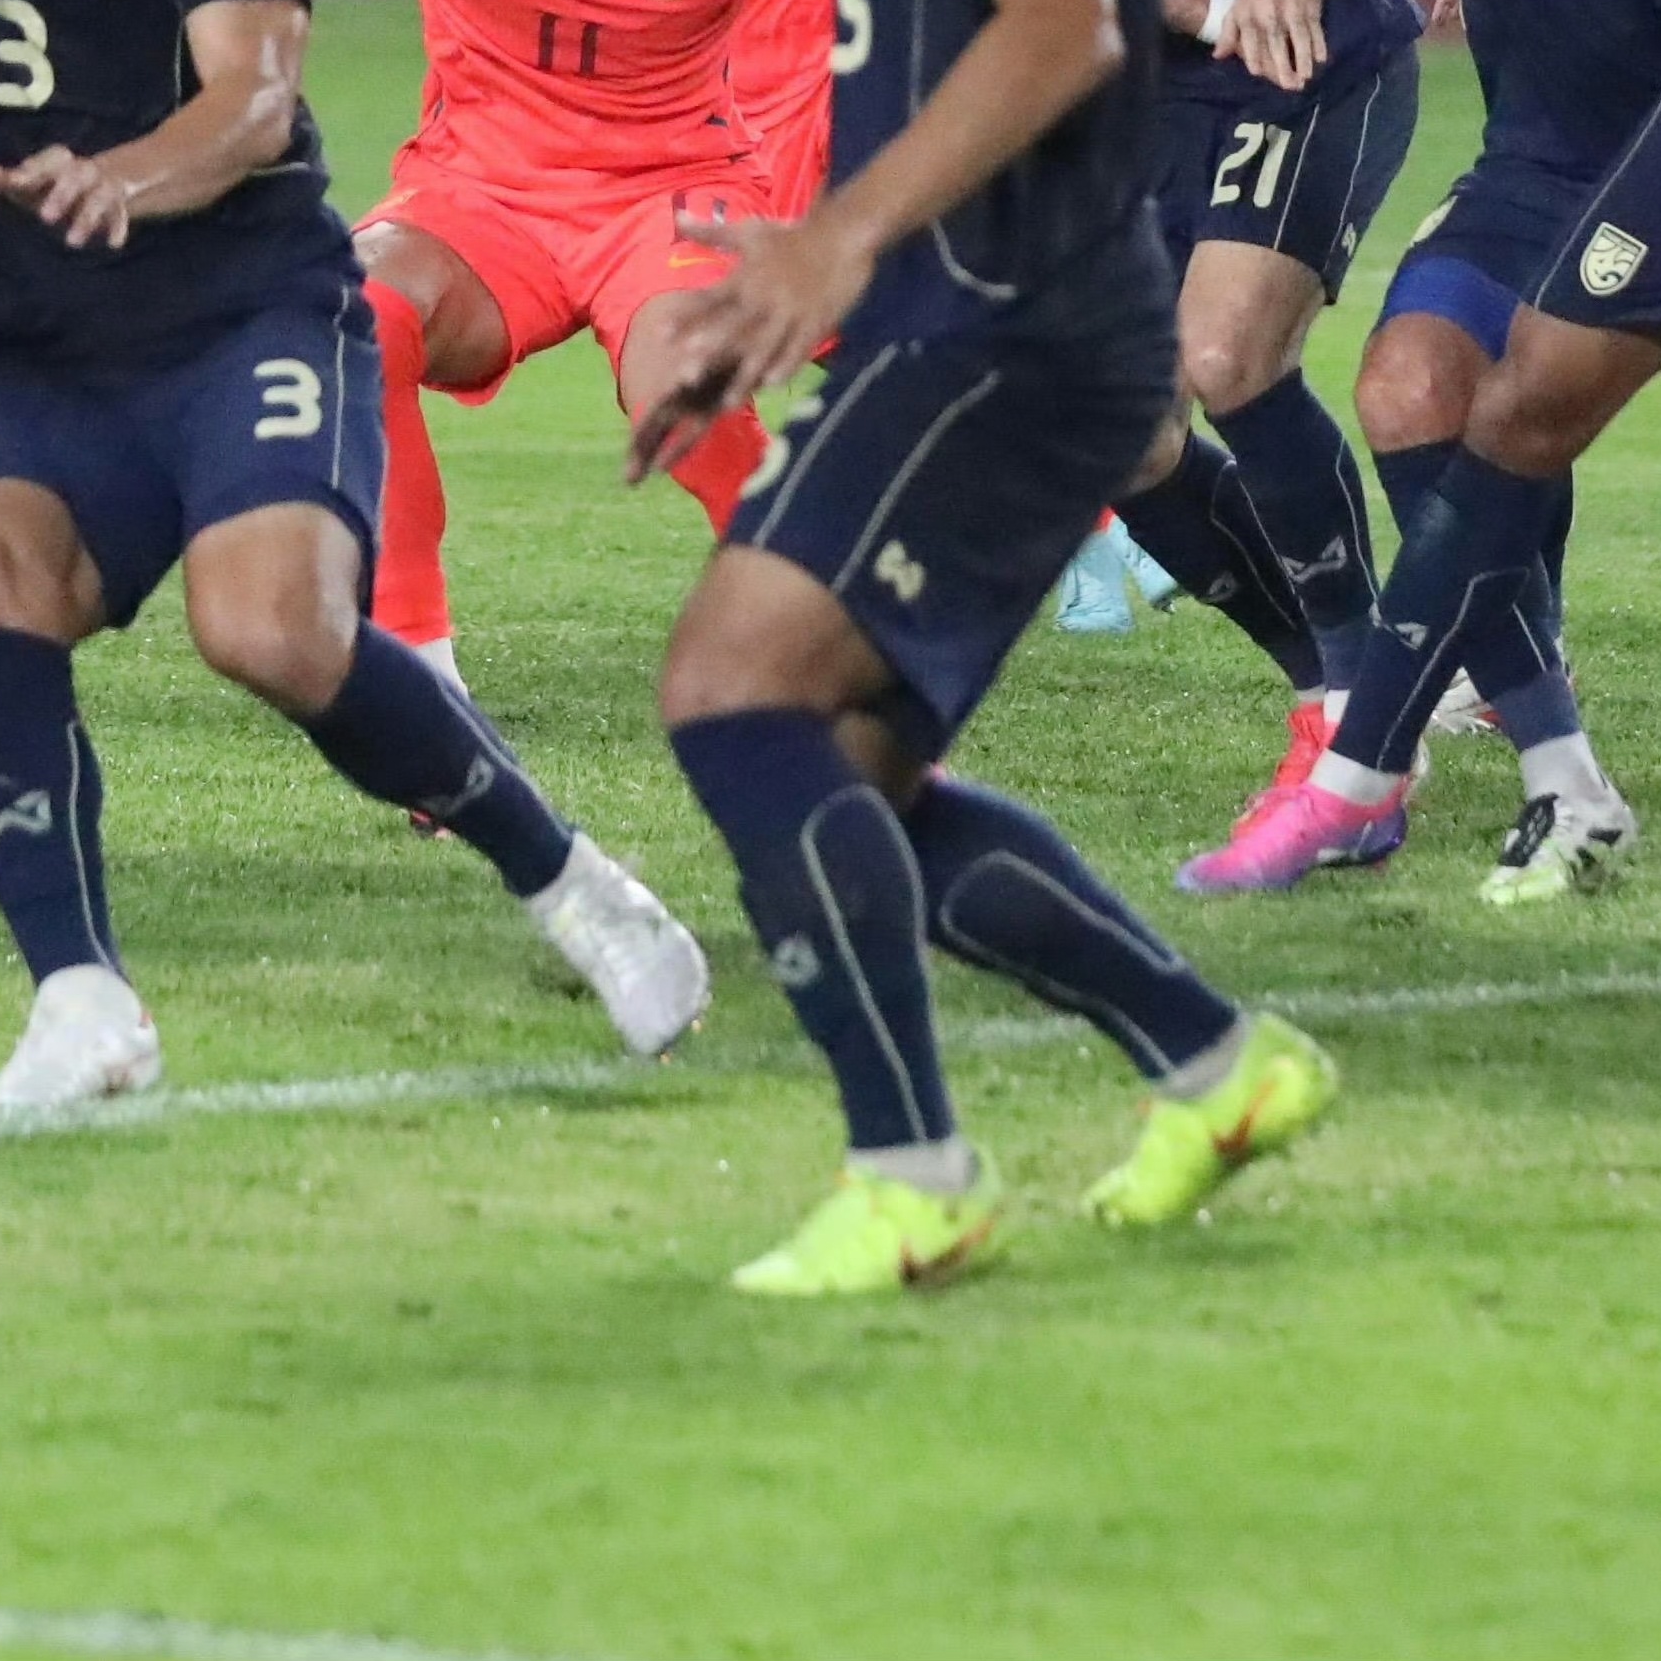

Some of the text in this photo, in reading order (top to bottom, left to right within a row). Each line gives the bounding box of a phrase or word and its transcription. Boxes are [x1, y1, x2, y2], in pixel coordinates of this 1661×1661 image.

[537, 11, 603, 78] 11
[1210, 122, 1292, 208] 21
[252, 357, 323, 440] 3
